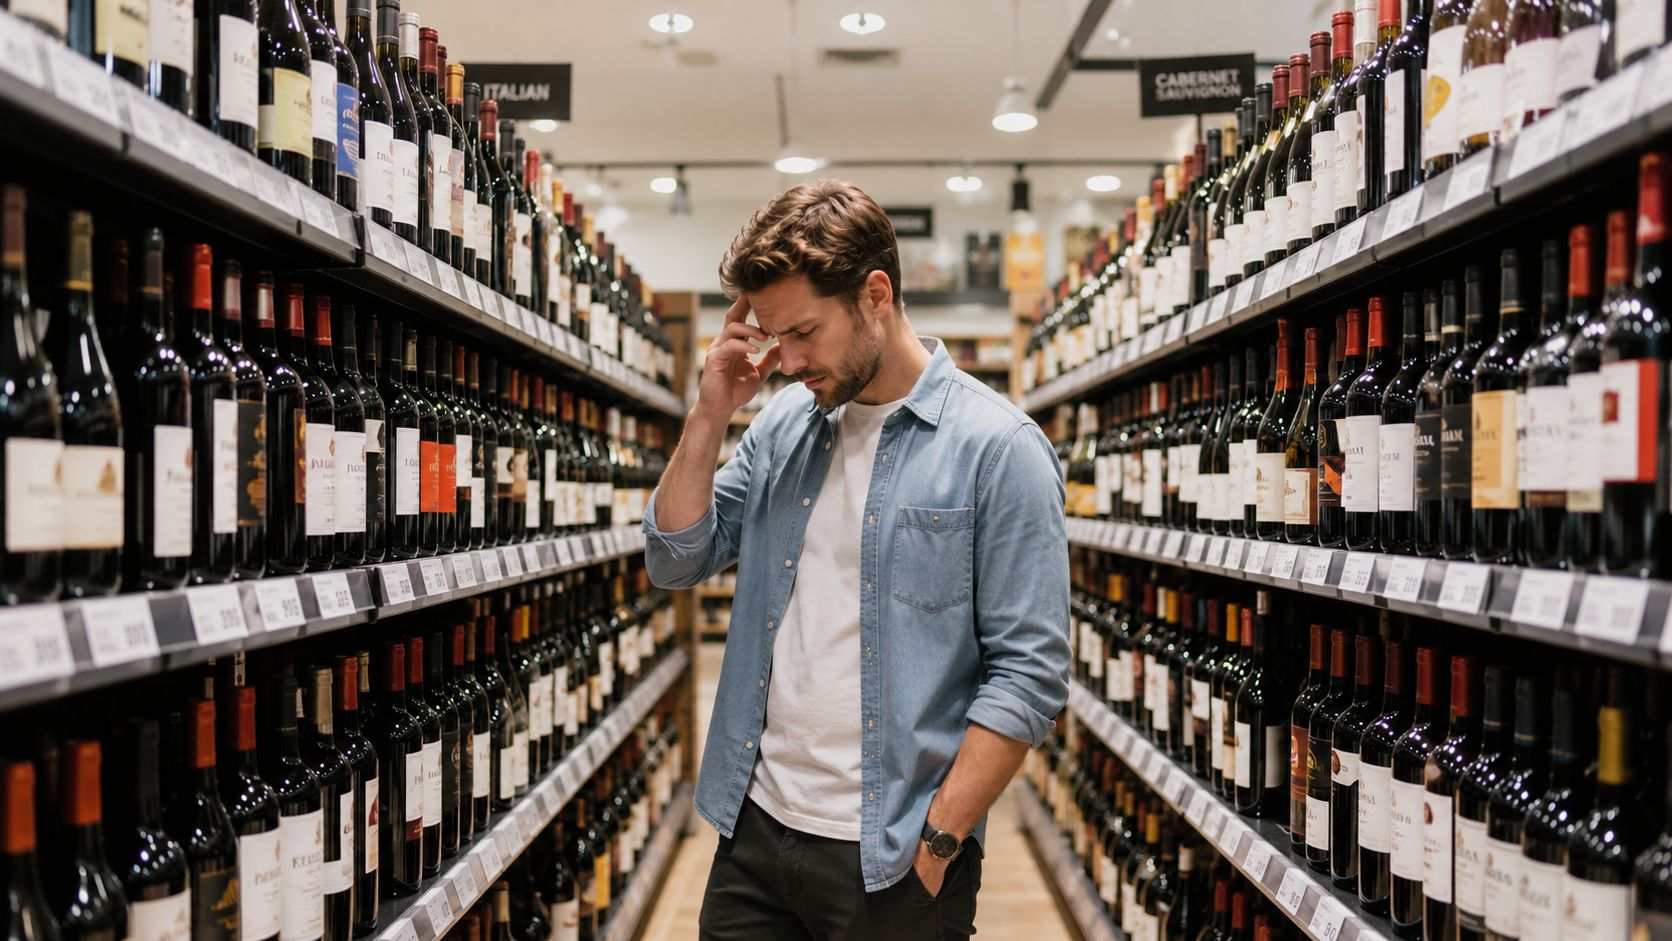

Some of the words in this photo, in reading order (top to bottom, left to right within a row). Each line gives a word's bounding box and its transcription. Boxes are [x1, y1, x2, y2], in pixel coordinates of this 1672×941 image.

[1155, 69, 1239, 87] CABERNET
[483, 83, 550, 101] ITALIAN
[1155, 83, 1241, 101] SAUVIGNON
